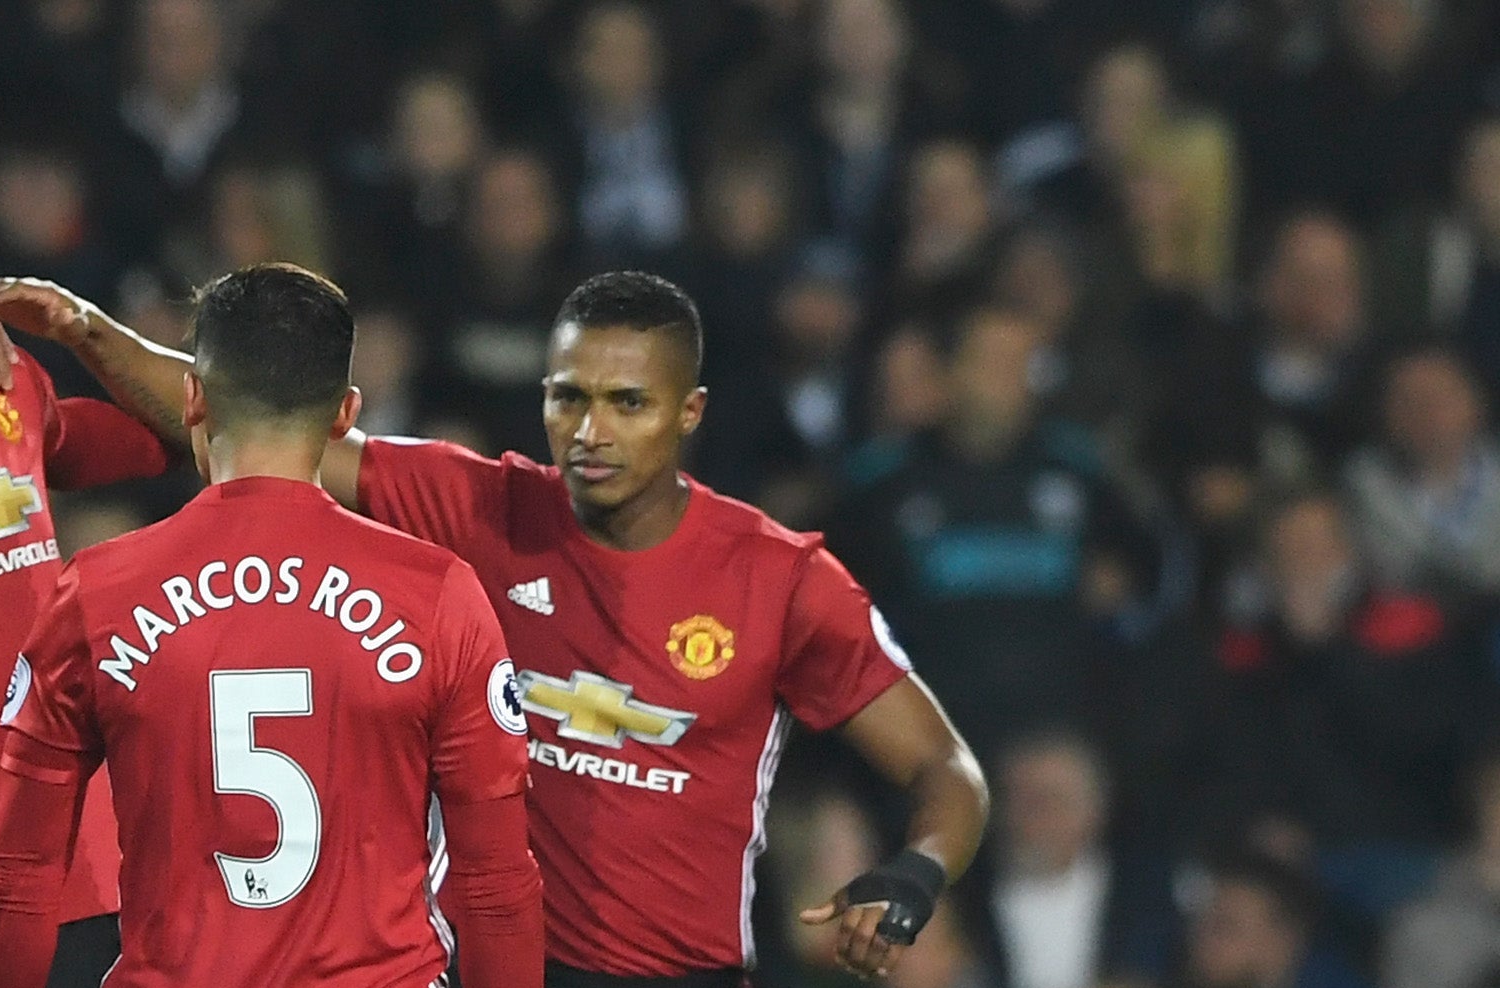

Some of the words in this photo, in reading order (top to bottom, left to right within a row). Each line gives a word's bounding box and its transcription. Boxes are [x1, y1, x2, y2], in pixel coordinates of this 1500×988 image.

[98, 556, 304, 692] MARCOS
[309, 565, 424, 684] ROJO
[209, 668, 323, 909] 5
